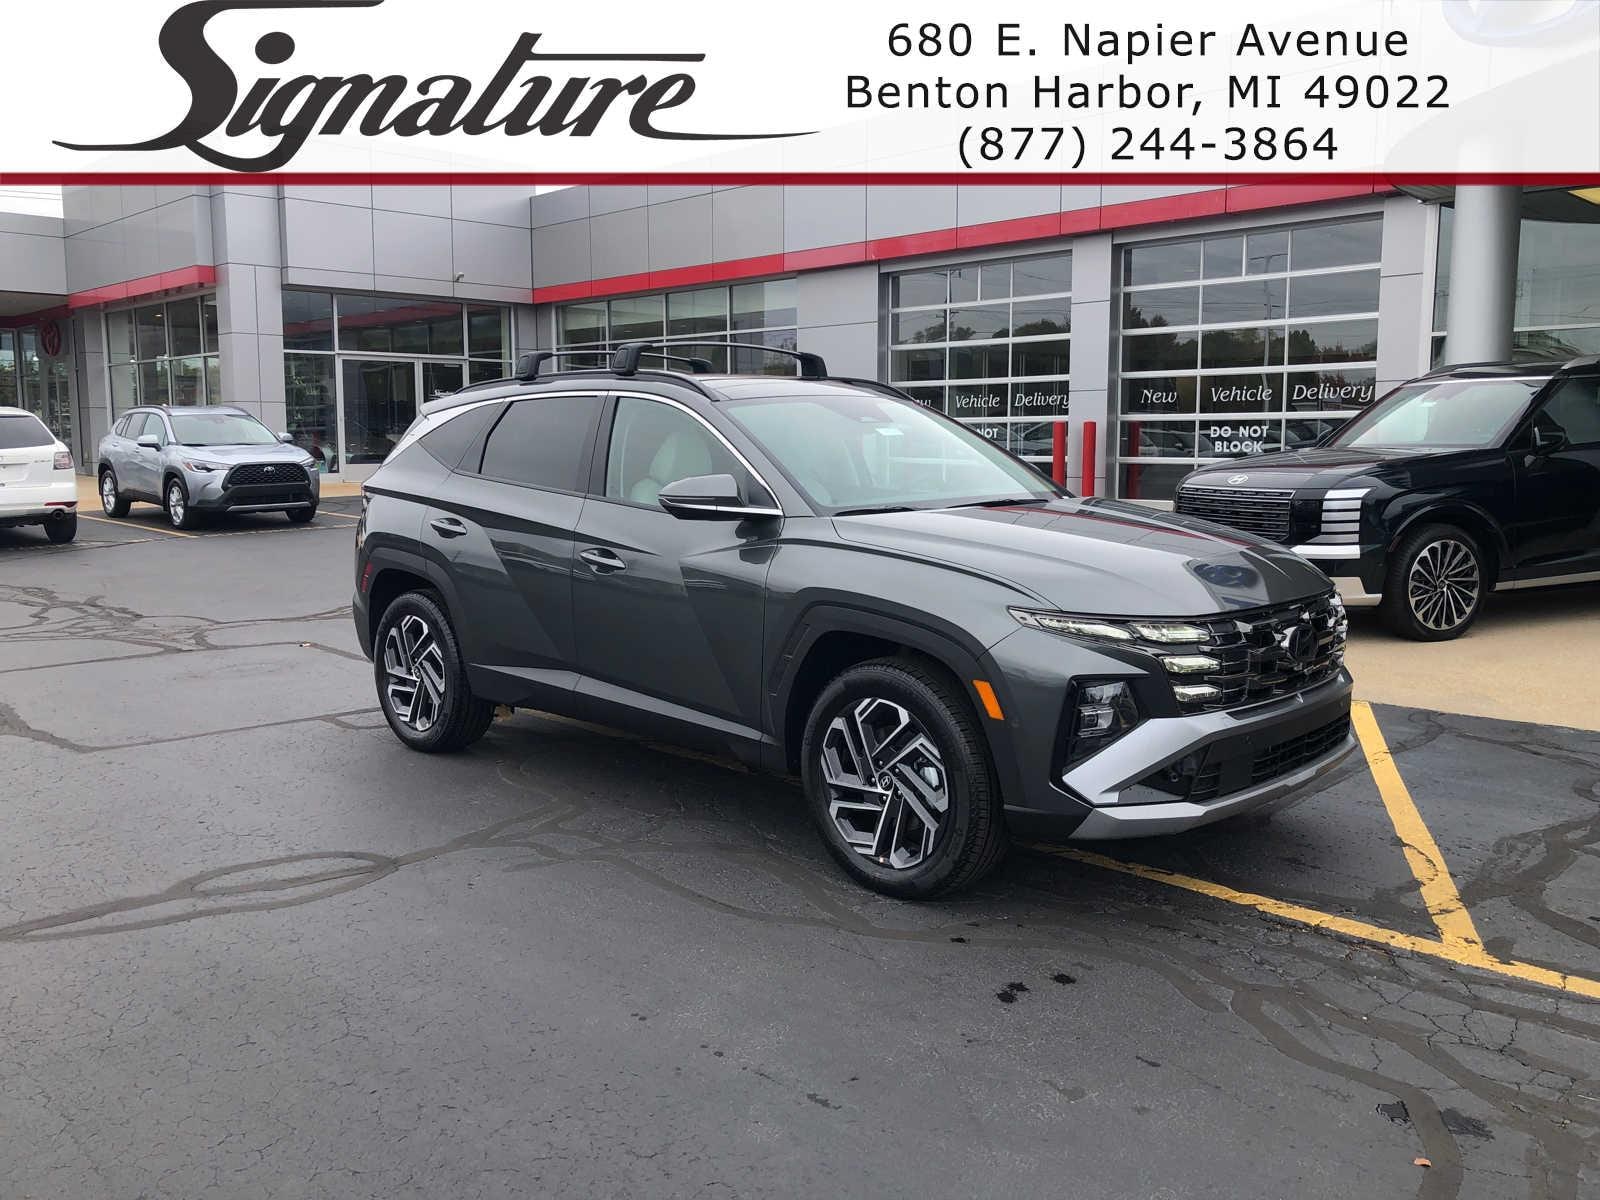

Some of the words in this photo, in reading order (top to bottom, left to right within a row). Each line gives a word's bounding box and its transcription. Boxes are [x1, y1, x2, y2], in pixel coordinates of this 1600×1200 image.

[955, 393, 1000, 408] Vehicle
[1014, 392, 1070, 409] Delivery
[1141, 389, 1177, 404] New
[1210, 385, 1273, 403] Vehicle
[1292, 383, 1374, 402] Delivery
[1210, 426, 1232, 438] DO
[1238, 425, 1270, 438] NOT
[1214, 440, 1264, 453] BLOCK
